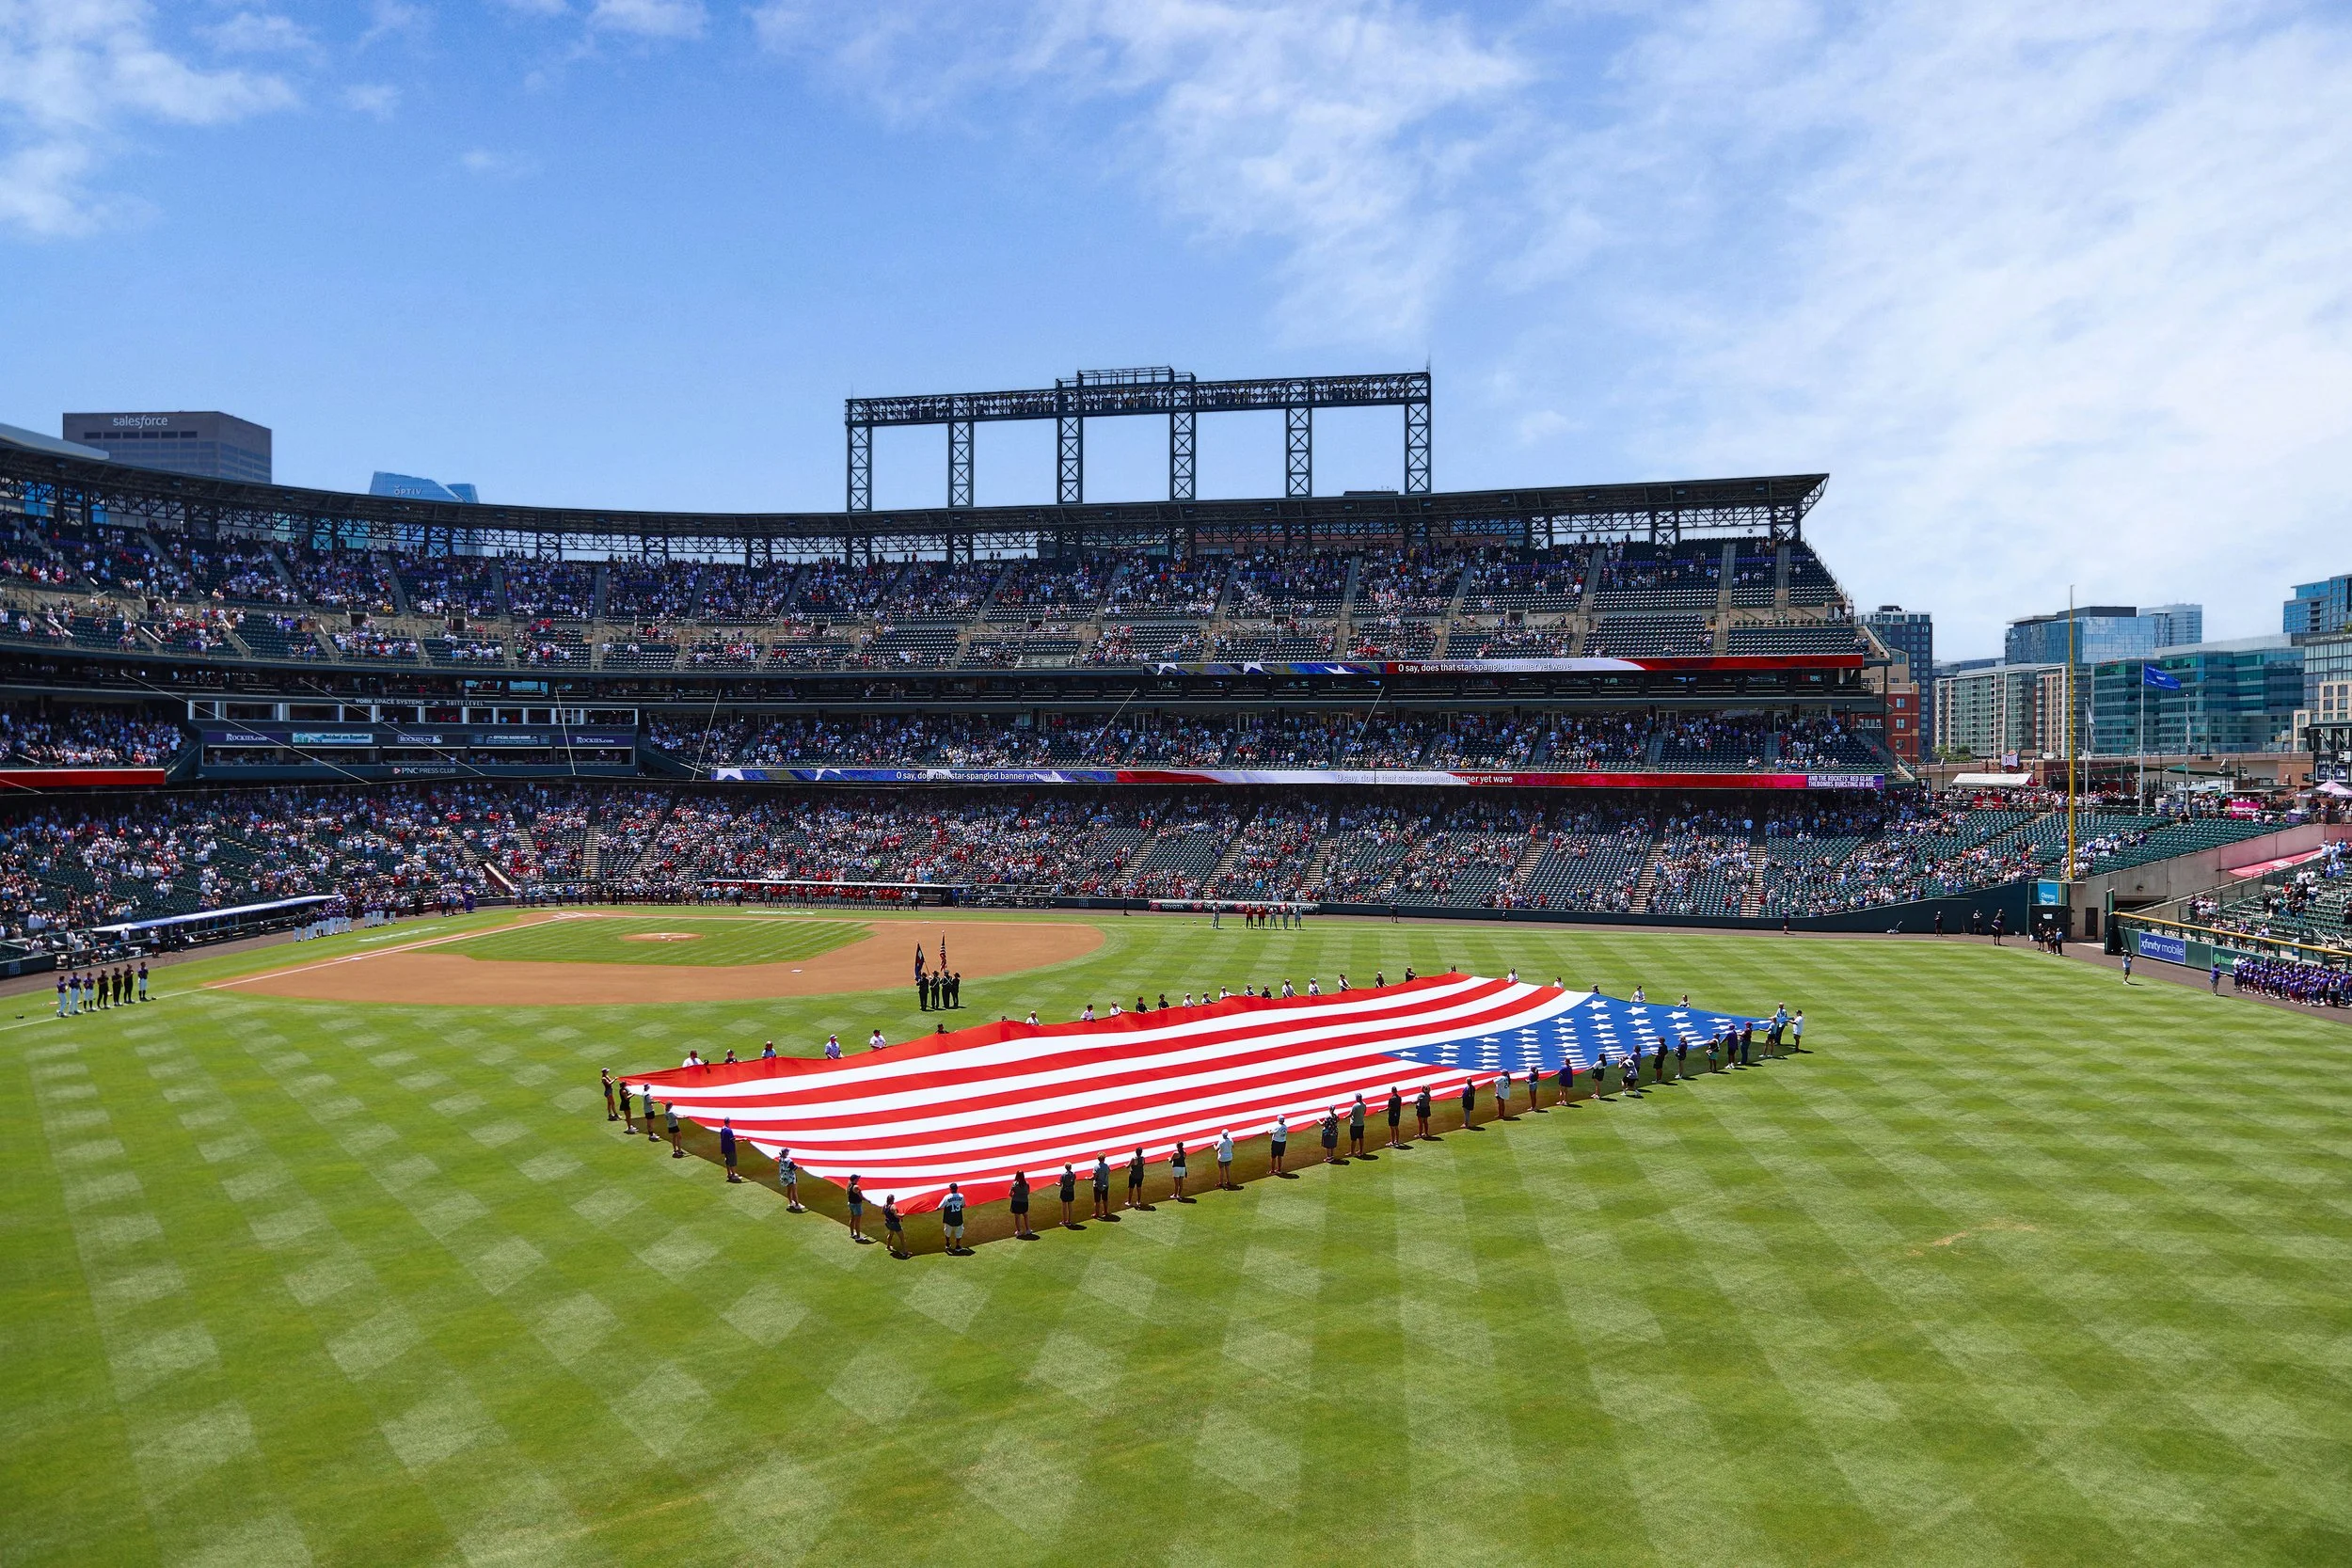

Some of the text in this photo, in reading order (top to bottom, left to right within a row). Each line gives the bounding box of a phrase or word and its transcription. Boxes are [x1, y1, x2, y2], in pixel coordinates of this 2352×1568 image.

[113, 415, 168, 429] salesforce
[394, 486, 422, 496] OPTIV
[1406, 665, 1420, 673] say,
[1457, 663, 1509, 673] star-spangled
[1511, 662, 1538, 671] banner
[903, 772, 916, 781] say,
[950, 771, 999, 781] star-spangled
[1000, 771, 1025, 780] banner
[1480, 775, 1492, 784] yet
[2140, 938, 2184, 956] xfinity mobile
[950, 1203, 961, 1212] 13
